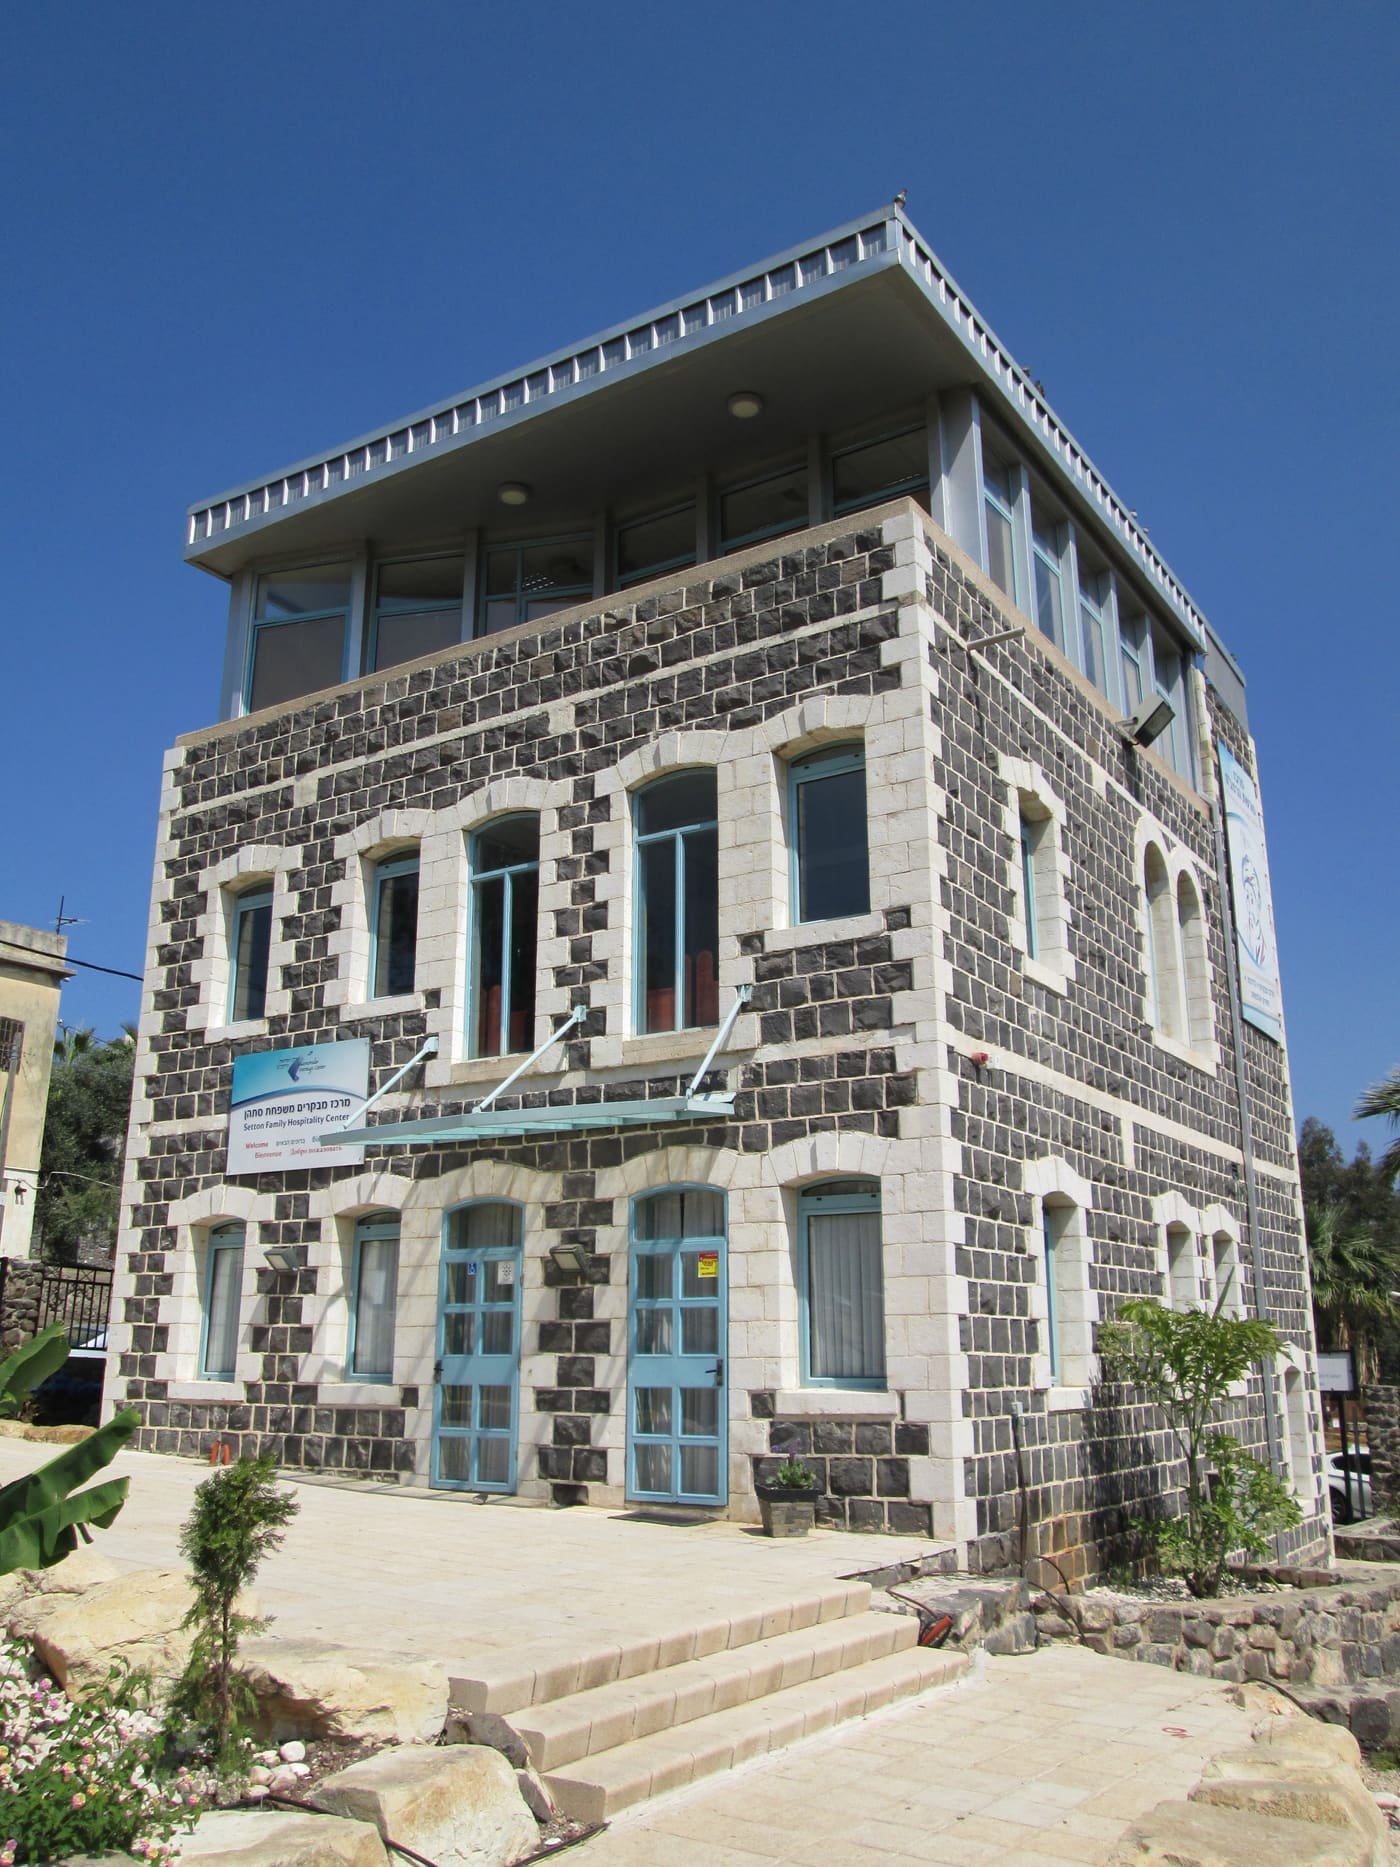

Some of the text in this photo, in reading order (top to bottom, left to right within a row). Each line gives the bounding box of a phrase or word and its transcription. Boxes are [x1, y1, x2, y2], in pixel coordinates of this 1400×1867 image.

[297, 1101, 328, 1112] מבקרים
[331, 1098, 351, 1108] מרכז
[265, 1104, 295, 1116] משפחת
[243, 1114, 350, 1131] Setton Family Hospitality Center
